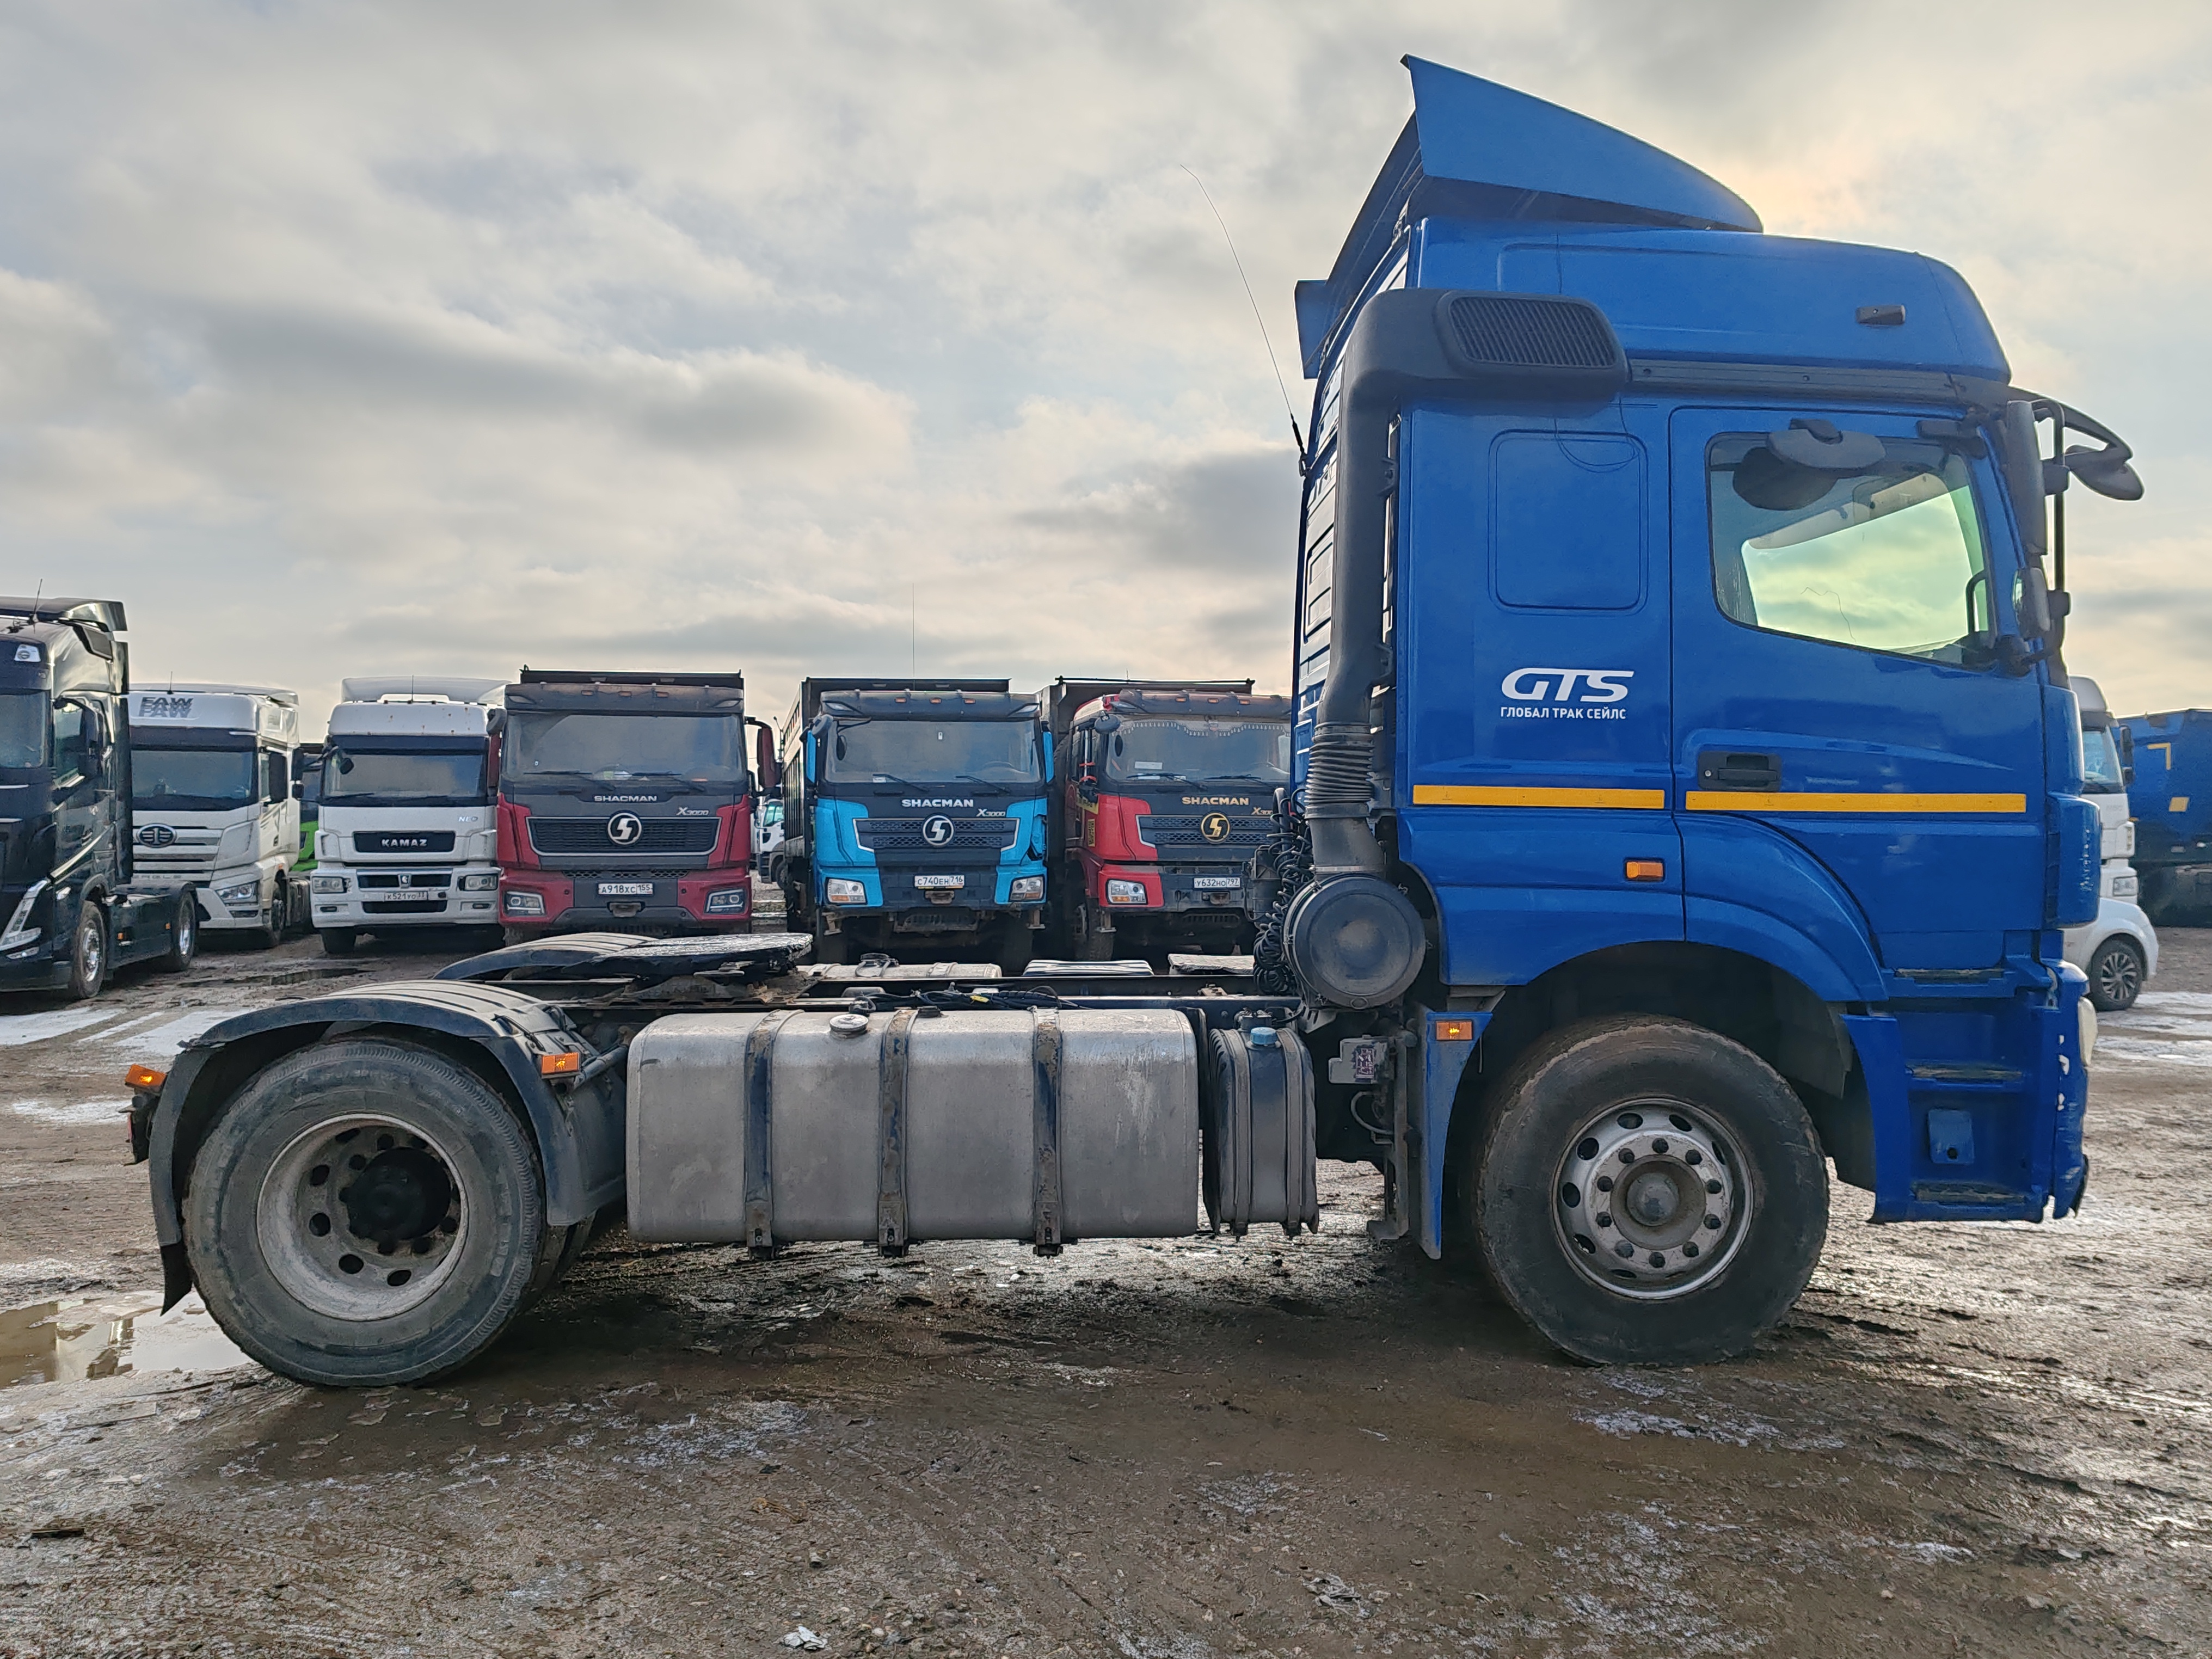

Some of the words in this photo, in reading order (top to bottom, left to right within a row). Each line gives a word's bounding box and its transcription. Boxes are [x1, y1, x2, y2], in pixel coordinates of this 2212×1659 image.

[1501, 667, 1635, 702] GTS
[138, 697, 194, 718] FAW
[1500, 706, 1549, 718] ГЛОБАЛ
[1552, 708, 1583, 719] ТРАК
[1587, 706, 1626, 720] СЕЙЛС
[901, 798, 974, 807] SHACMAN
[1182, 796, 1249, 806] SHACMAN
[675, 807, 709, 816] X3000
[976, 808, 1006, 817] X3000
[382, 839, 427, 847] KAMAZ
